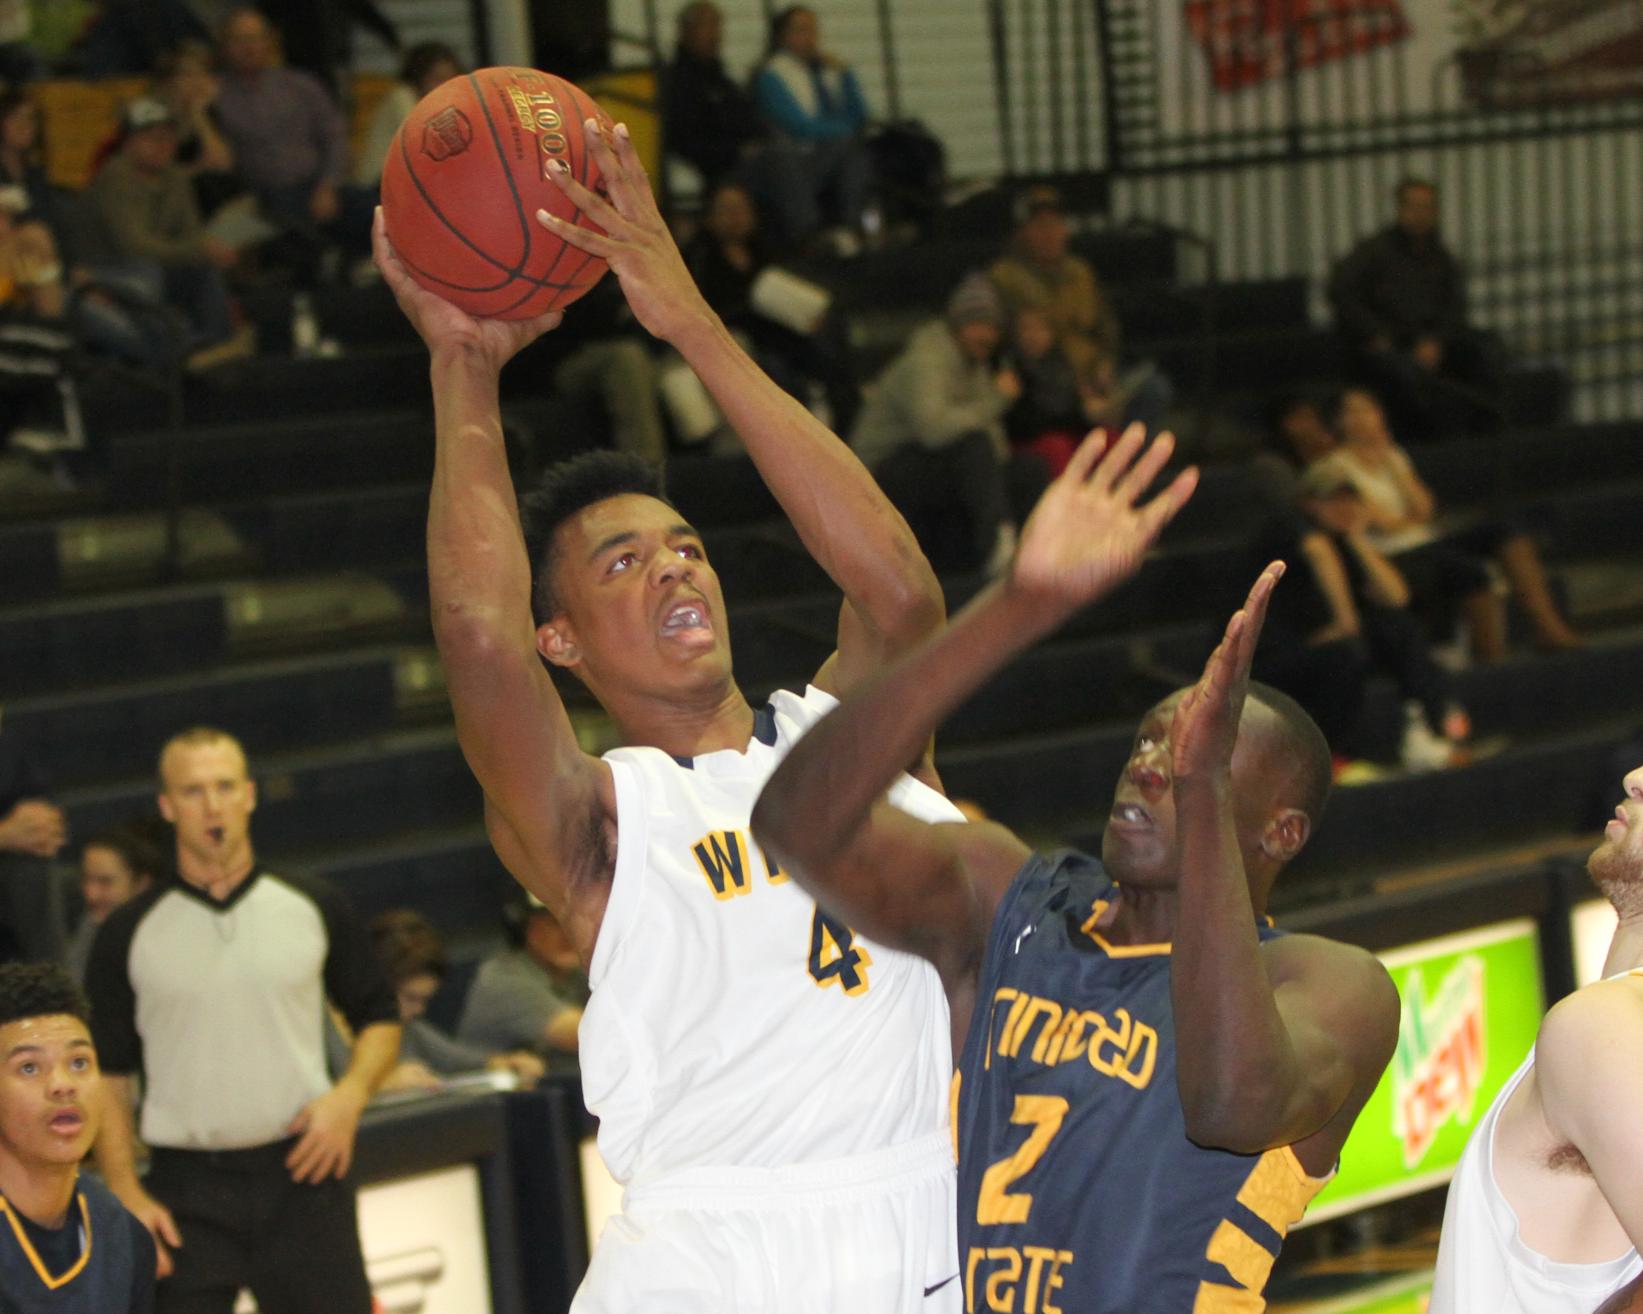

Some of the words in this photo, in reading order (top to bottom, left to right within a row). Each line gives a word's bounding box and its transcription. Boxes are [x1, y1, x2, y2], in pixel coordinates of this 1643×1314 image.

[808, 899, 873, 997] 4
[984, 987, 1158, 1090] INIDAD
[976, 1094, 1070, 1225] 2
